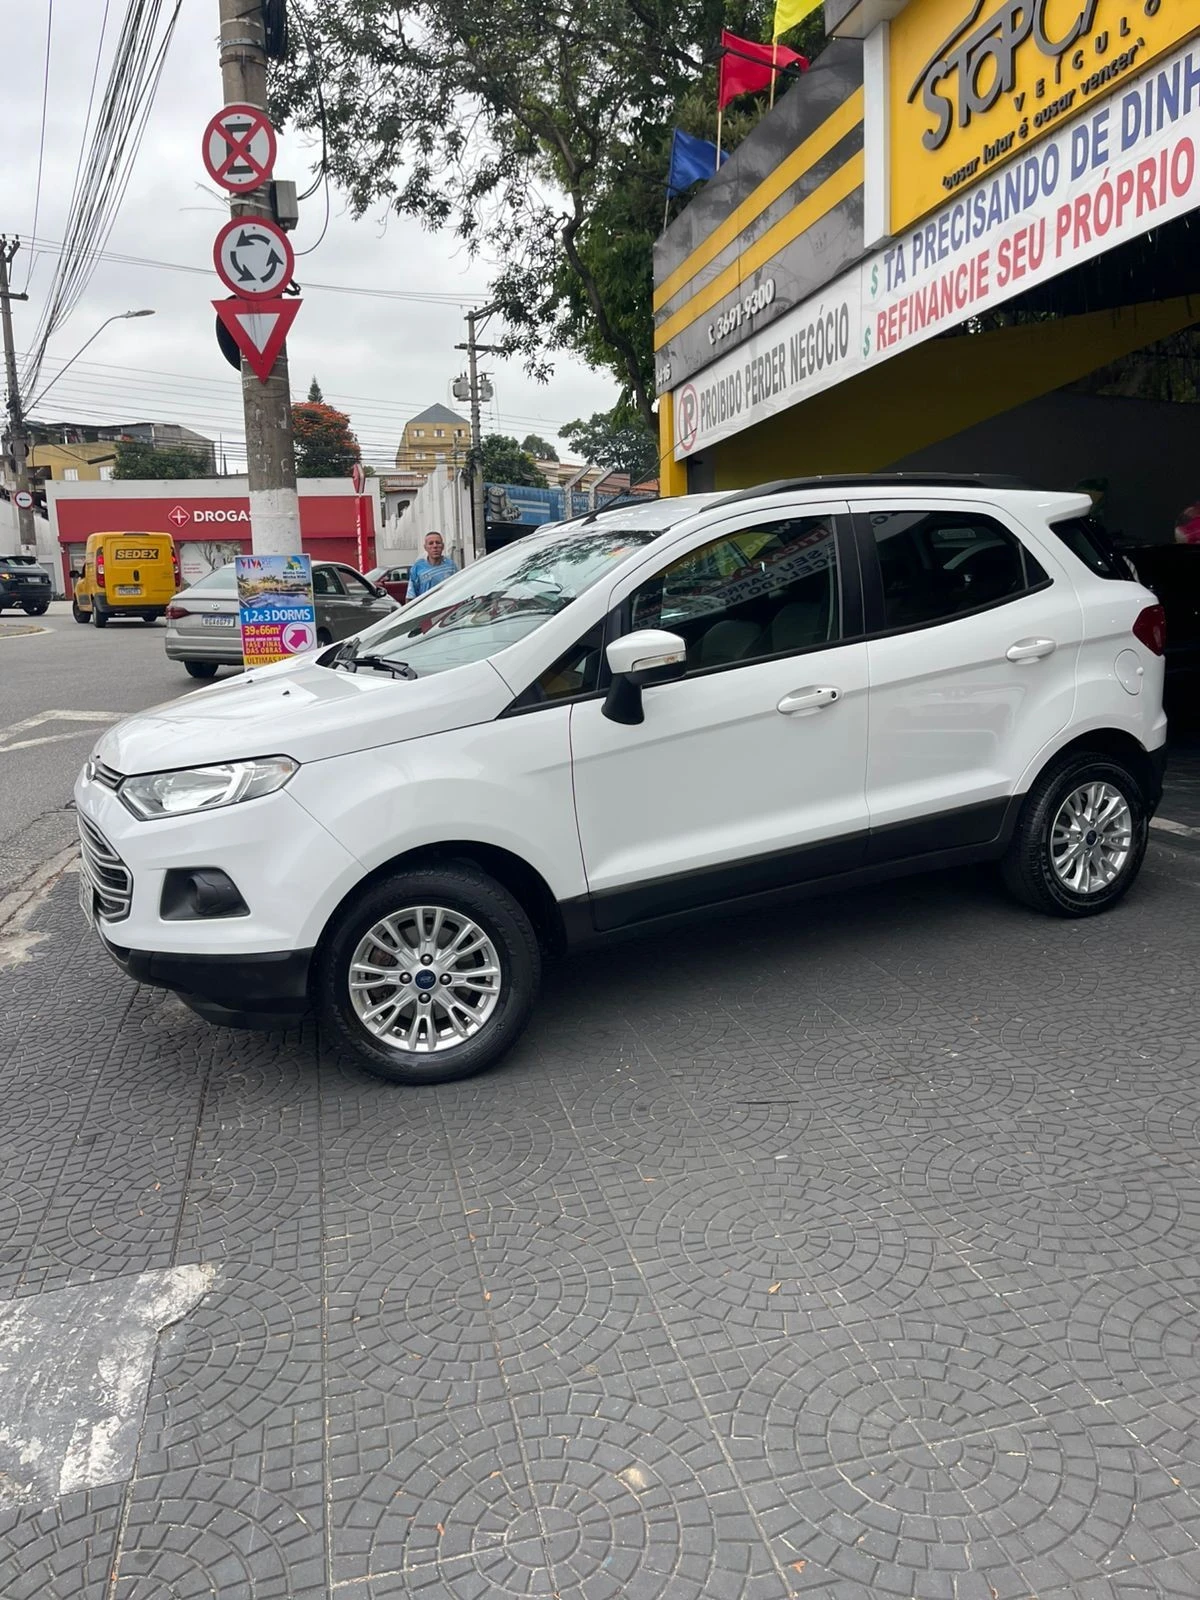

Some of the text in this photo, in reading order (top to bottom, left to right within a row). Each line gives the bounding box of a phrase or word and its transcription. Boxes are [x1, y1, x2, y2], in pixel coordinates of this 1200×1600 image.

[1018, 117, 1029, 139] é
[1033, 88, 1076, 127] ousar
[912, 143, 1060, 277] PRECISANDO
[1070, 107, 1110, 182] DE
[876, 248, 990, 352] REFINANCIE
[996, 217, 1046, 288] SEU
[1055, 136, 1195, 258] PRÓPRIO
[716, 278, 775, 340] 3691-9300
[700, 369, 742, 433] PROIBIDO
[745, 341, 788, 409] PERDER
[791, 302, 849, 386] NEGÓCIO
[193, 510, 251, 522] DROGA
[117, 549, 157, 559] SEDEX
[272, 609, 311, 620] DORMS
